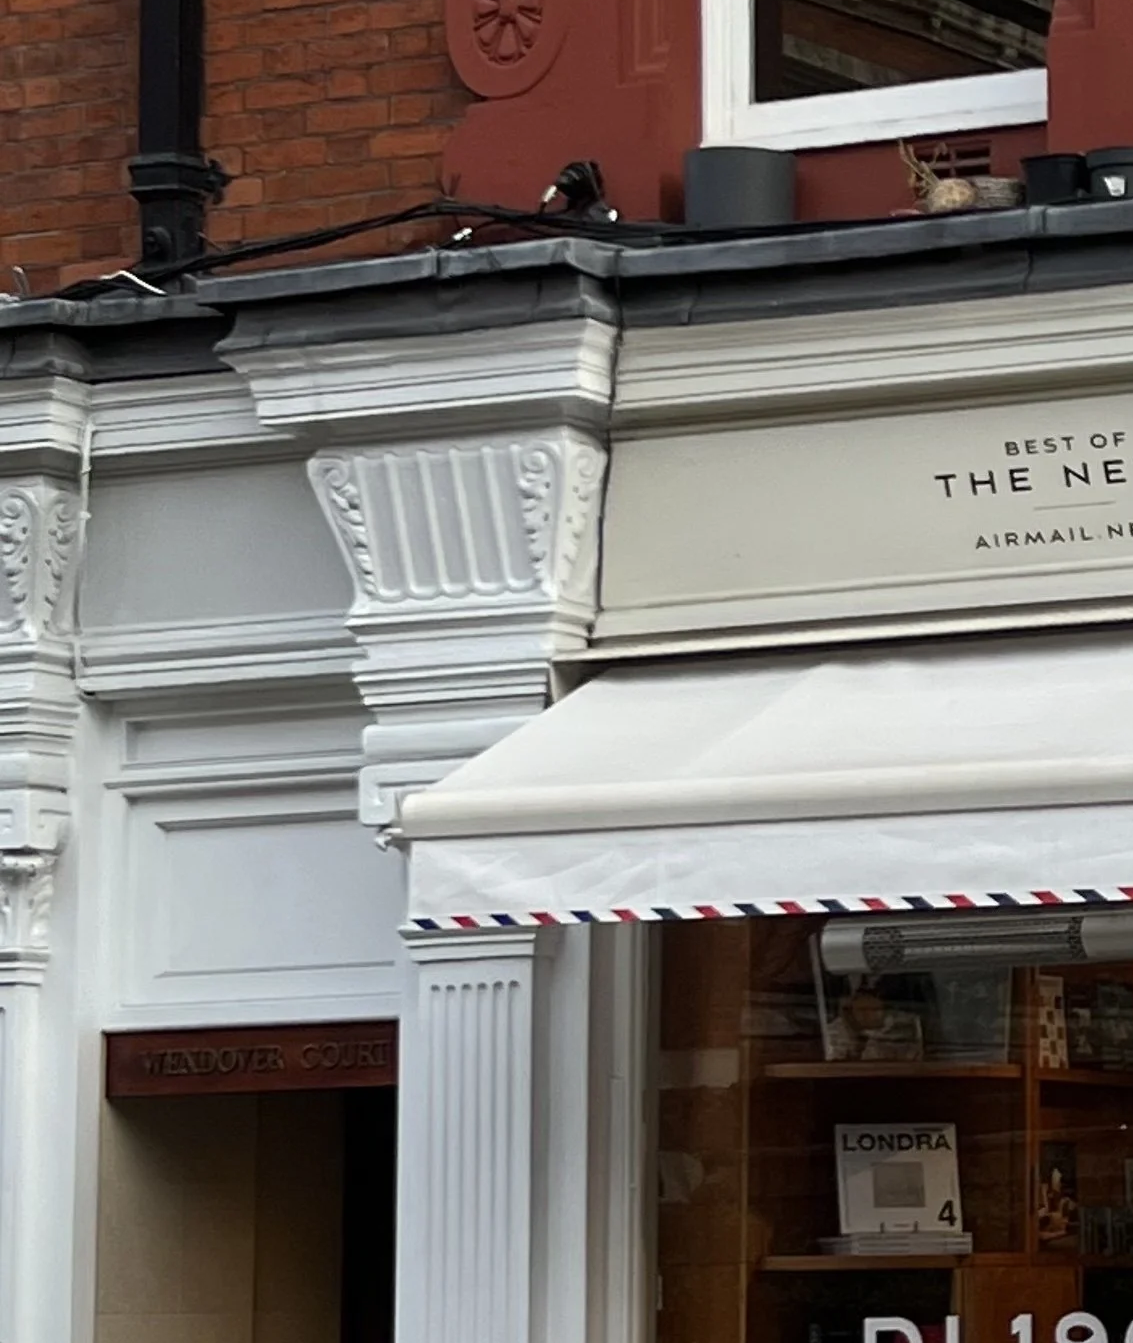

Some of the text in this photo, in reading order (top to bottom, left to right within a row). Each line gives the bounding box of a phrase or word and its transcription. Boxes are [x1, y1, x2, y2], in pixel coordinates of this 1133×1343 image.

[1004, 431, 1127, 456] BEST OF
[934, 467, 1032, 498] THE
[145, 1038, 389, 1075] WENDOVER COURT
[841, 1132, 952, 1153] LONDRA
[937, 1199, 957, 1227] 4
